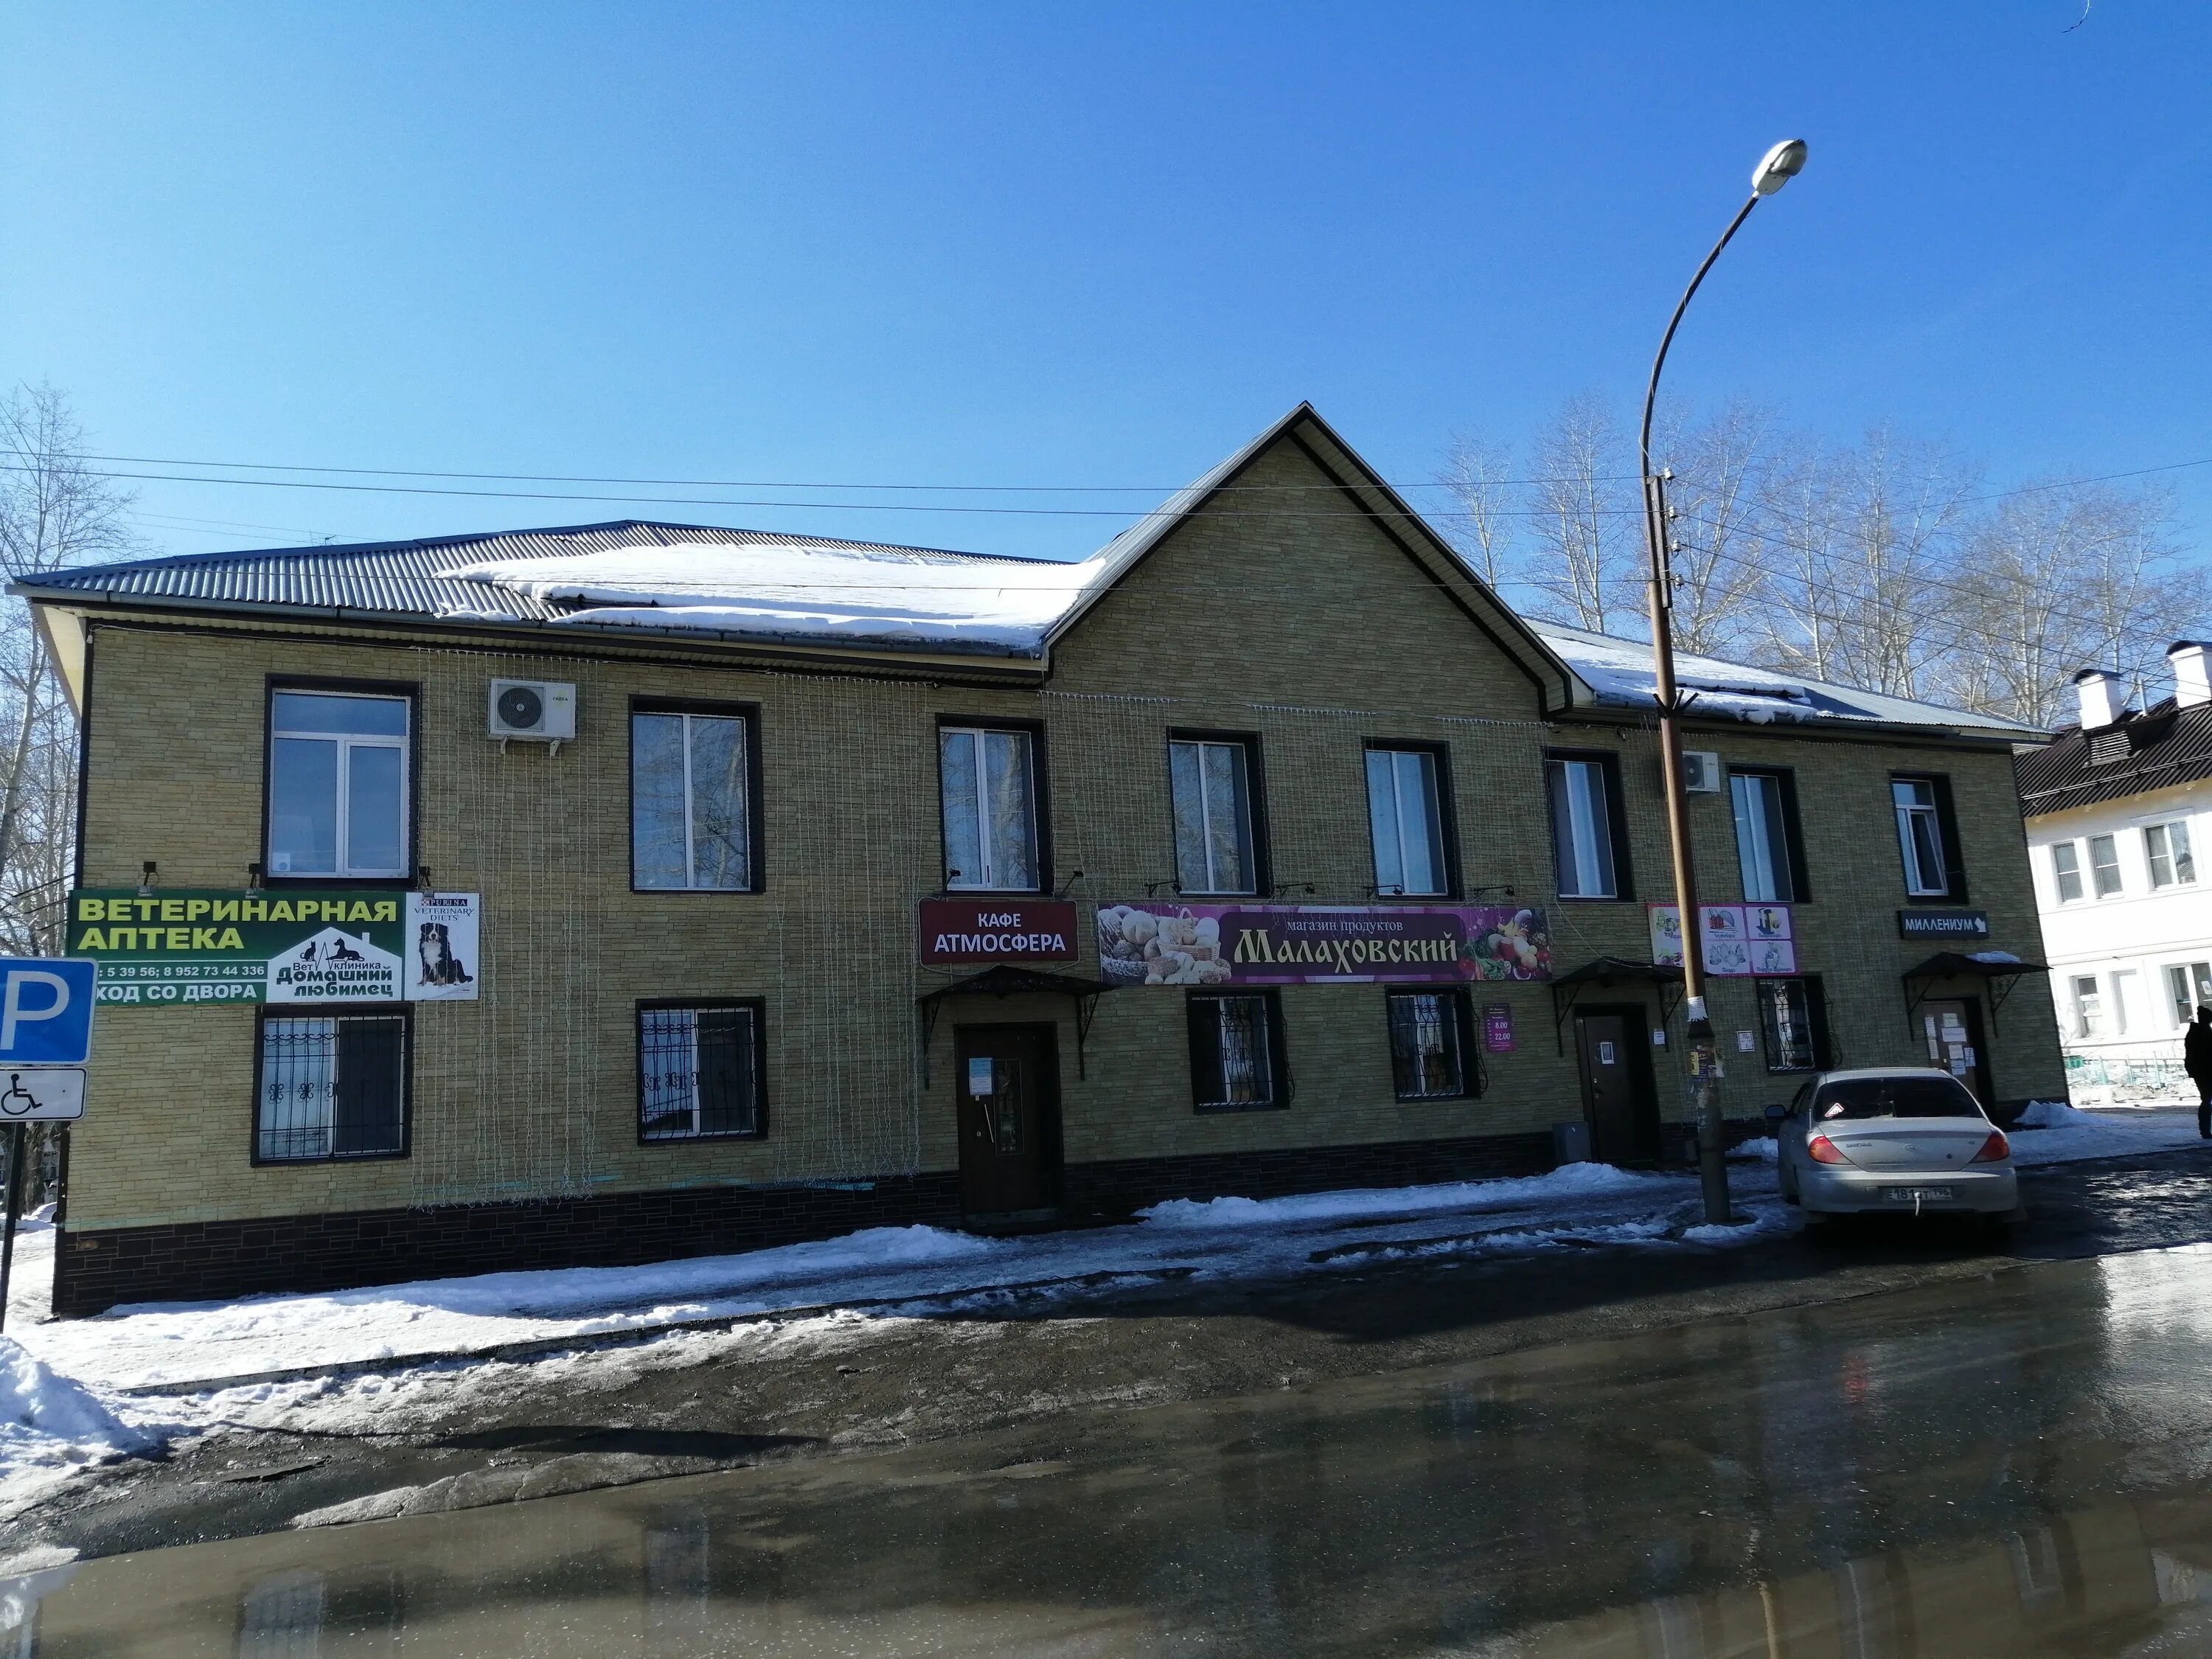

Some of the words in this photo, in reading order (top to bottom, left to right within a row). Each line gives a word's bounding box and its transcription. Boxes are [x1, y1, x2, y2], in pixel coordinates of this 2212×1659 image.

[78, 899, 397, 922] ВЕТЕРИНАРНАЯ
[414, 908, 475, 917] VETERINARY
[978, 913, 1022, 928] КАФЕ
[1287, 922, 1337, 931] магазин
[1340, 922, 1404, 934] продуктов
[1905, 918, 1974, 931] МИЛЛЕНИУМ
[77, 928, 244, 950] АПТЕКА
[934, 933, 1066, 952] АТМОСФЕРА
[1234, 929, 1458, 974] Малаховский
[107, 967, 115, 977] 5
[119, 967, 136, 977] 39
[164, 967, 172, 976] 8
[175, 967, 199, 976] 952
[204, 966, 219, 976] 73
[222, 966, 238, 975] 44
[242, 966, 265, 975] 336
[293, 962, 313, 970] Вет
[276, 966, 392, 985] Домашний
[96, 986, 141, 1002] ХОД
[147, 985, 177, 1000] СО
[182, 984, 257, 1002] ДВОРА
[294, 982, 393, 997] любимец
[1, 970, 70, 1050] P
